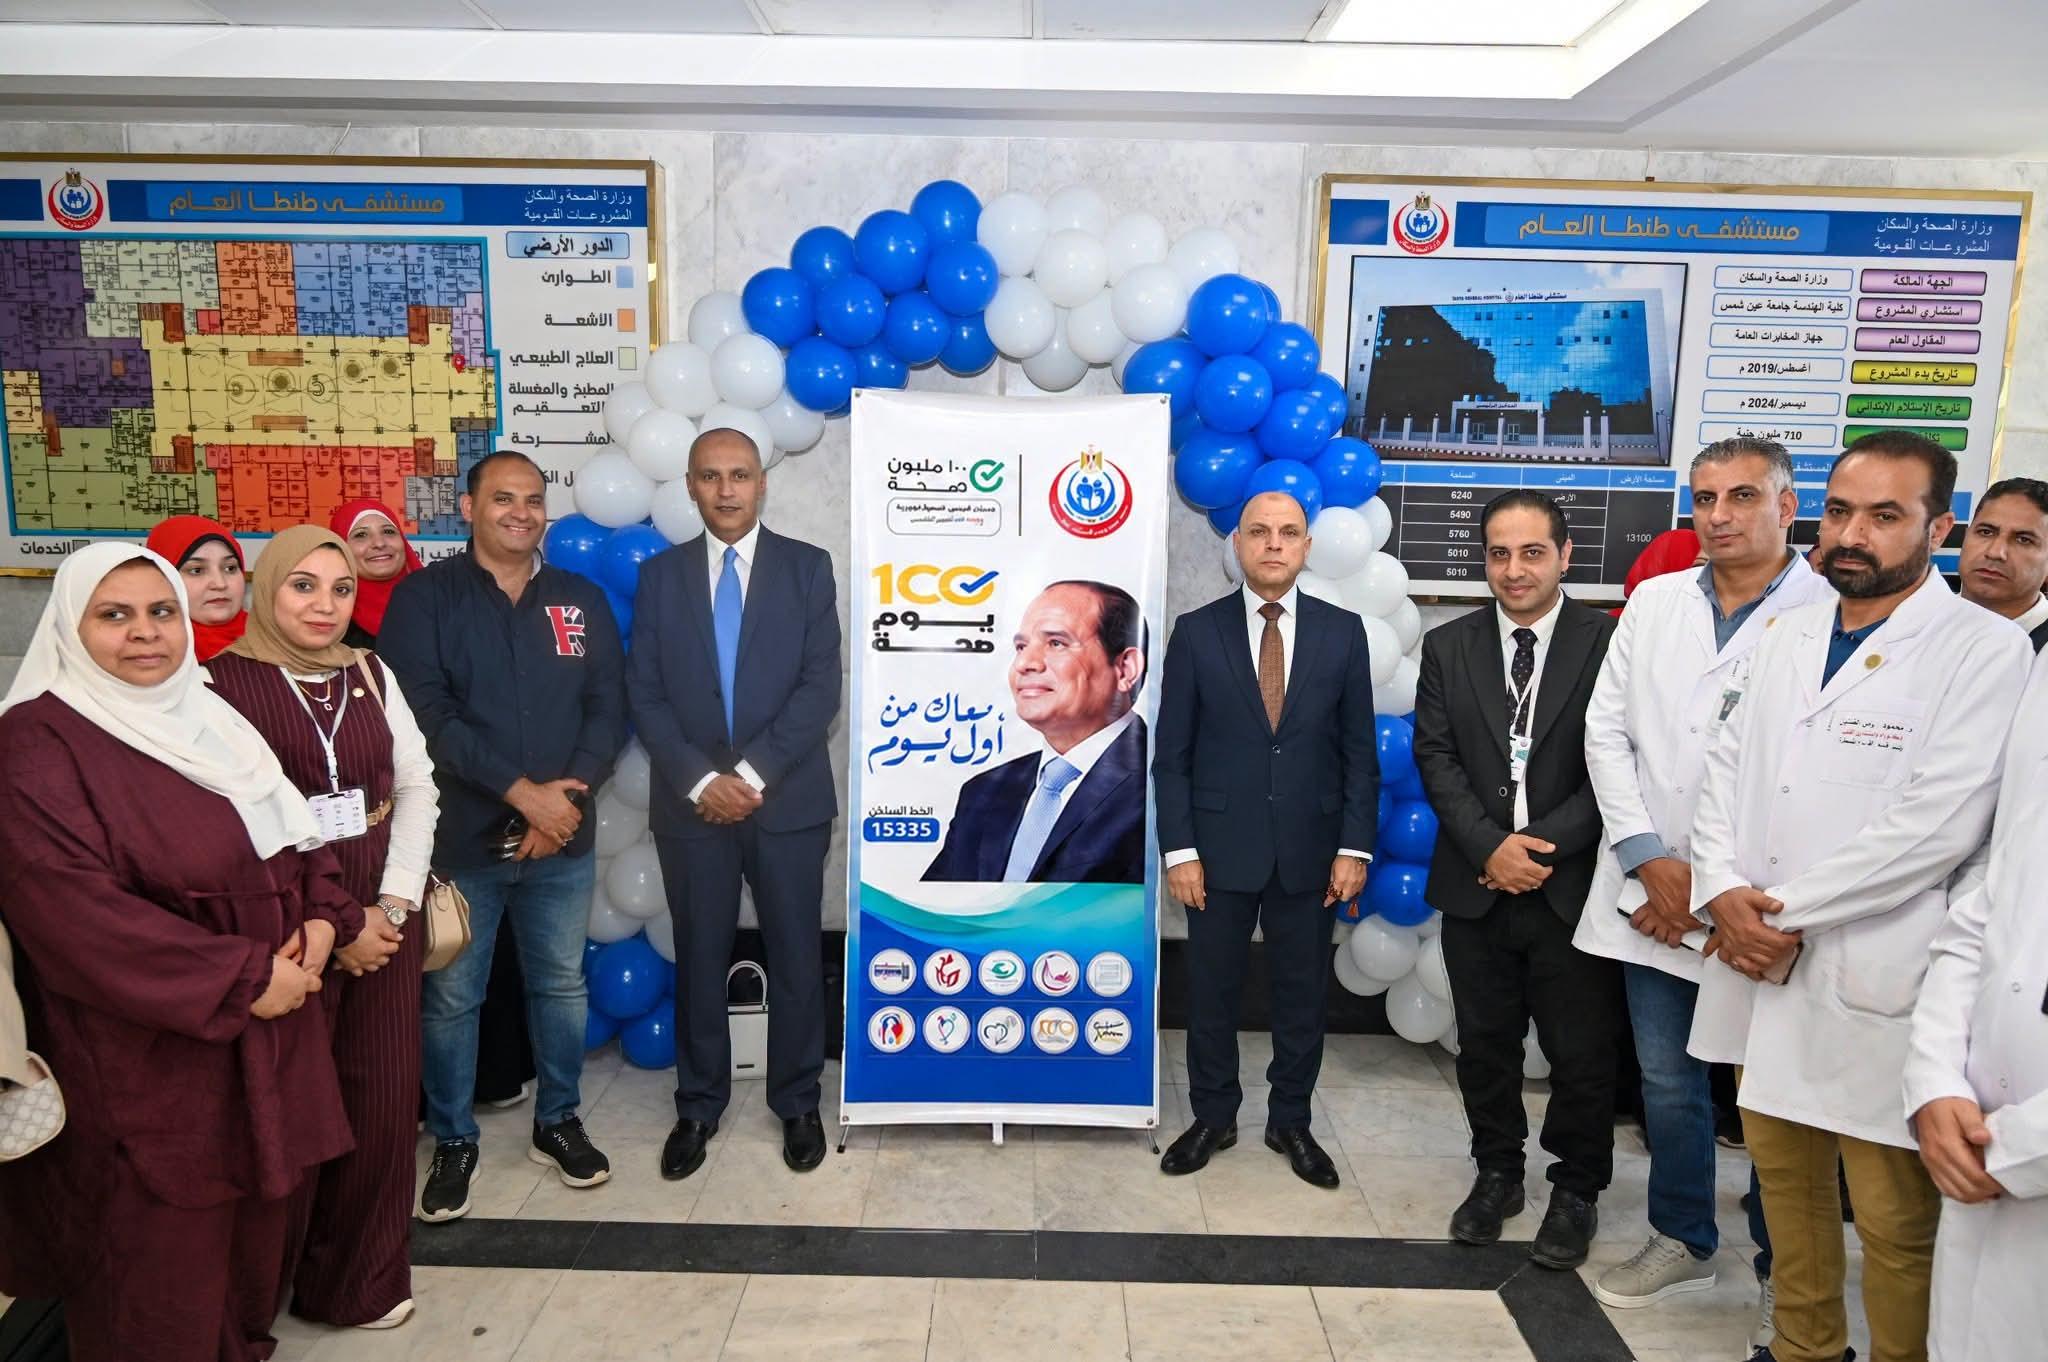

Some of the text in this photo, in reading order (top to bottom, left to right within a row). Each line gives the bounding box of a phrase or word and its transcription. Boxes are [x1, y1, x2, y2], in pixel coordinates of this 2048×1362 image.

[169, 189, 446, 216] مستشفى طنطا العام
[525, 188, 632, 204] وزارة الصحة والسكان
[524, 207, 632, 223] المشروعات القومية
[1519, 213, 1801, 241] مستشفى طنطا العام
[1877, 217, 1993, 235] وزارة الصحة والسكان
[523, 234, 613, 258] الدور الأرضي
[1874, 236, 1990, 255] المشروعات القومية
[1739, 271, 1828, 285] وزارة الصحة والسكان
[1893, 274, 1953, 290] الجهة المالكة
[1720, 299, 1844, 314] كلية الهندسة جامعة عين شمس
[1875, 304, 1963, 319] استشاري المشروع
[544, 312, 613, 327] الأشعة
[1735, 329, 1823, 344] جهاز المخابرات العامة
[1888, 334, 1946, 349] المقاول العام
[509, 350, 614, 367] العلاج الطبيعي
[1869, 367, 1958, 382] تاريخ بدء المشروع
[508, 382, 614, 399] المطبخ والمغسلة
[1935, 402, 1961, 417] تاريخ
[1784, 430, 1802, 440] 710
[1451, 490, 1473, 500] 6240
[1450, 510, 1471, 519] 5490
[1448, 529, 1470, 539] 5760
[1625, 533, 1652, 543] 13100
[20, 541, 71, 555] الخدمات
[1447, 549, 1469, 558] 5010
[1446, 568, 1467, 577] 5010
[871, 563, 999, 605] 100
[872, 610, 995, 633] يوم
[872, 632, 995, 653] صحة
[880, 692, 993, 727] معاك من
[867, 713, 1005, 774] أول يوم
[909, 805, 933, 816] الخط
[871, 821, 932, 837] 15335
